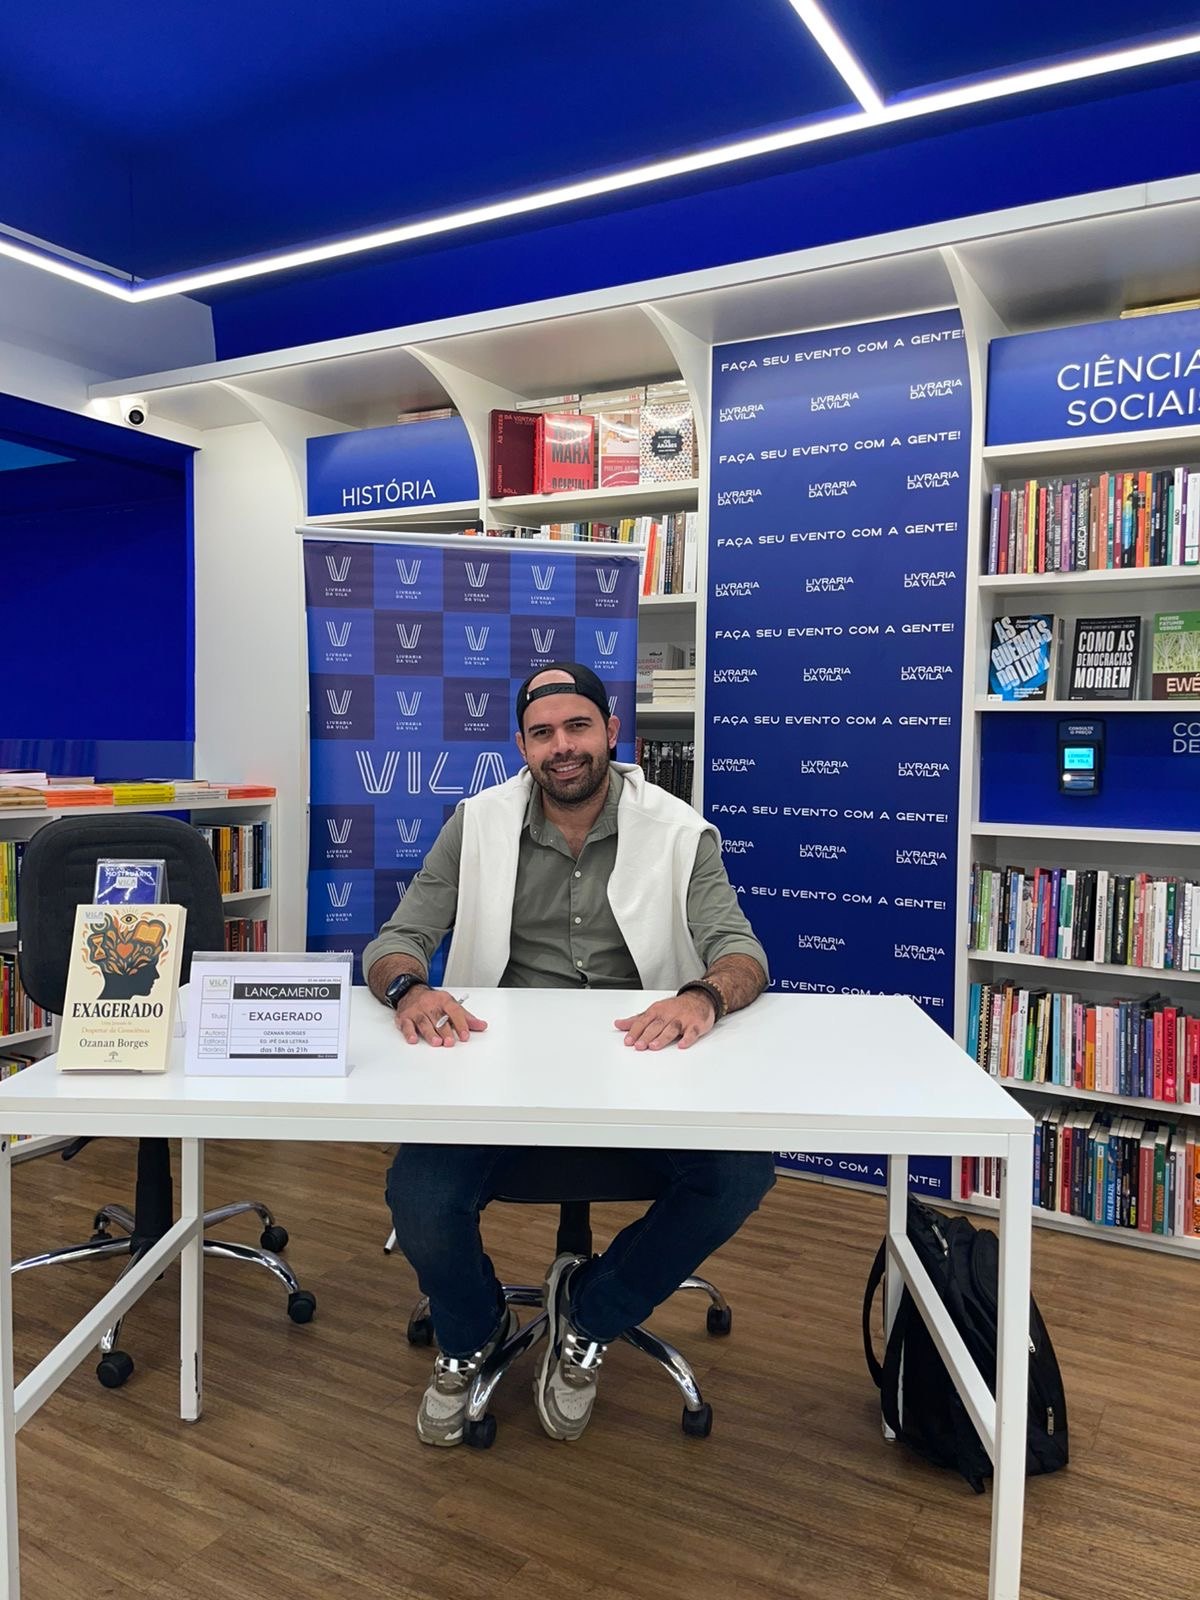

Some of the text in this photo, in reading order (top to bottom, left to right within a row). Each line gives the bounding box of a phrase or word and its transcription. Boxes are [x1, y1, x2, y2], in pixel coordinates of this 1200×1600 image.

[721, 329, 965, 372] FAÇA SEU EVENTO COM A GENTE!
[910, 379, 962, 392] LIVRARIA
[910, 388, 952, 399] DA VILA
[720, 404, 764, 416] LIVRARIA
[1067, 388, 1200, 426] SOCIAI
[720, 412, 756, 422] DA VILA
[552, 442, 590, 464] MARX
[719, 431, 960, 464] FAÇA SEU EVENTO COM A GENTE!
[343, 479, 435, 507] HISTÓRIA
[809, 480, 857, 491] LIVRARIA
[809, 487, 848, 498] DA VILA
[717, 522, 958, 547] FAÇA SEU EVENTO COM A GENTE!
[1077, 526, 1087, 558] CABEÇA
[904, 571, 956, 581] LIVRARIA
[904, 579, 946, 588] DA VILA
[715, 623, 954, 640] FAÇA SEU EVENTO COM A GENTE!
[994, 616, 1016, 644] AS
[991, 620, 1053, 670] GUERRAS
[1078, 630, 1135, 652] COMO AS
[1076, 652, 1133, 667] DEMOCRACIAS
[803, 667, 851, 675] LIVRARIA
[803, 674, 817, 682] DA
[1074, 667, 1131, 688] MORREM
[713, 716, 951, 726] FAÇA SEU EVENTO COM A GENTE!
[356, 751, 508, 794] VILA
[898, 762, 949, 770] LIVRARIA
[898, 769, 940, 778] DA VILA
[712, 805, 948, 823] FAÇA SEU EVENTO COM A GENTE!
[751, 886, 777, 896] SEU
[782, 889, 836, 901] EVENTO
[842, 893, 872, 904] COM
[878, 896, 888, 905] A
[895, 898, 946, 910] GENTE!
[895, 944, 945, 956] LIVRARIA
[895, 951, 936, 961] DA VILA
[245, 987, 329, 999] LANÇAMENTO
[781, 980, 835, 993] EVENTO
[842, 987, 870, 995] COM
[895, 993, 944, 1007] NTE!
[72, 1002, 163, 1018] EXAGERADO
[249, 1012, 322, 1021] EXAGERADO
[80, 1039, 149, 1049] Ozanan Borges
[780, 1152, 940, 1187] EVENTO COM A NTE!
